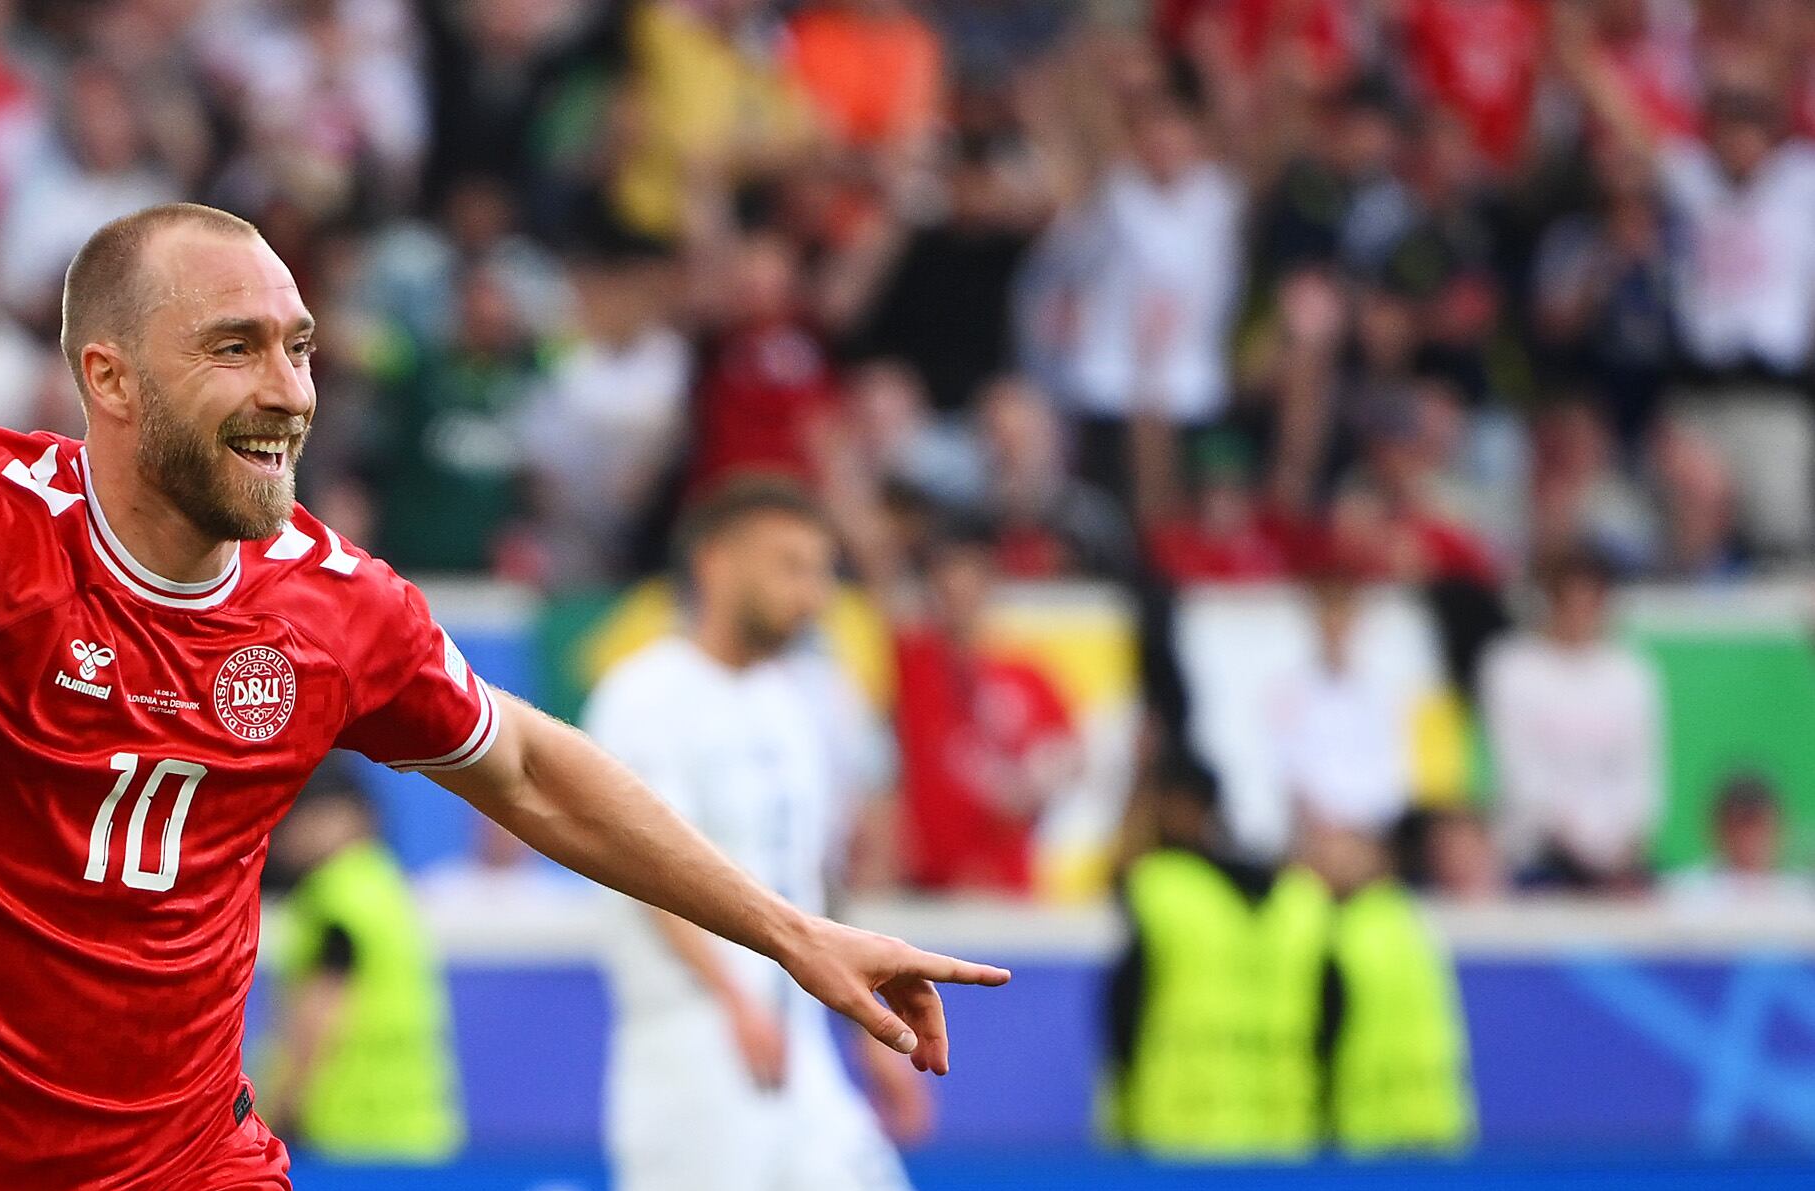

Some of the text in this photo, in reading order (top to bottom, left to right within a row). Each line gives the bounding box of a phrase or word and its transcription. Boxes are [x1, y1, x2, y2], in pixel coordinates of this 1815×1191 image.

[54, 670, 112, 700] hummel
[231, 677, 281, 707] DBU
[217, 675, 238, 730] DANSK
[276, 673, 294, 724] UNION
[242, 723, 274, 739] 1889
[83, 751, 209, 892] 10
